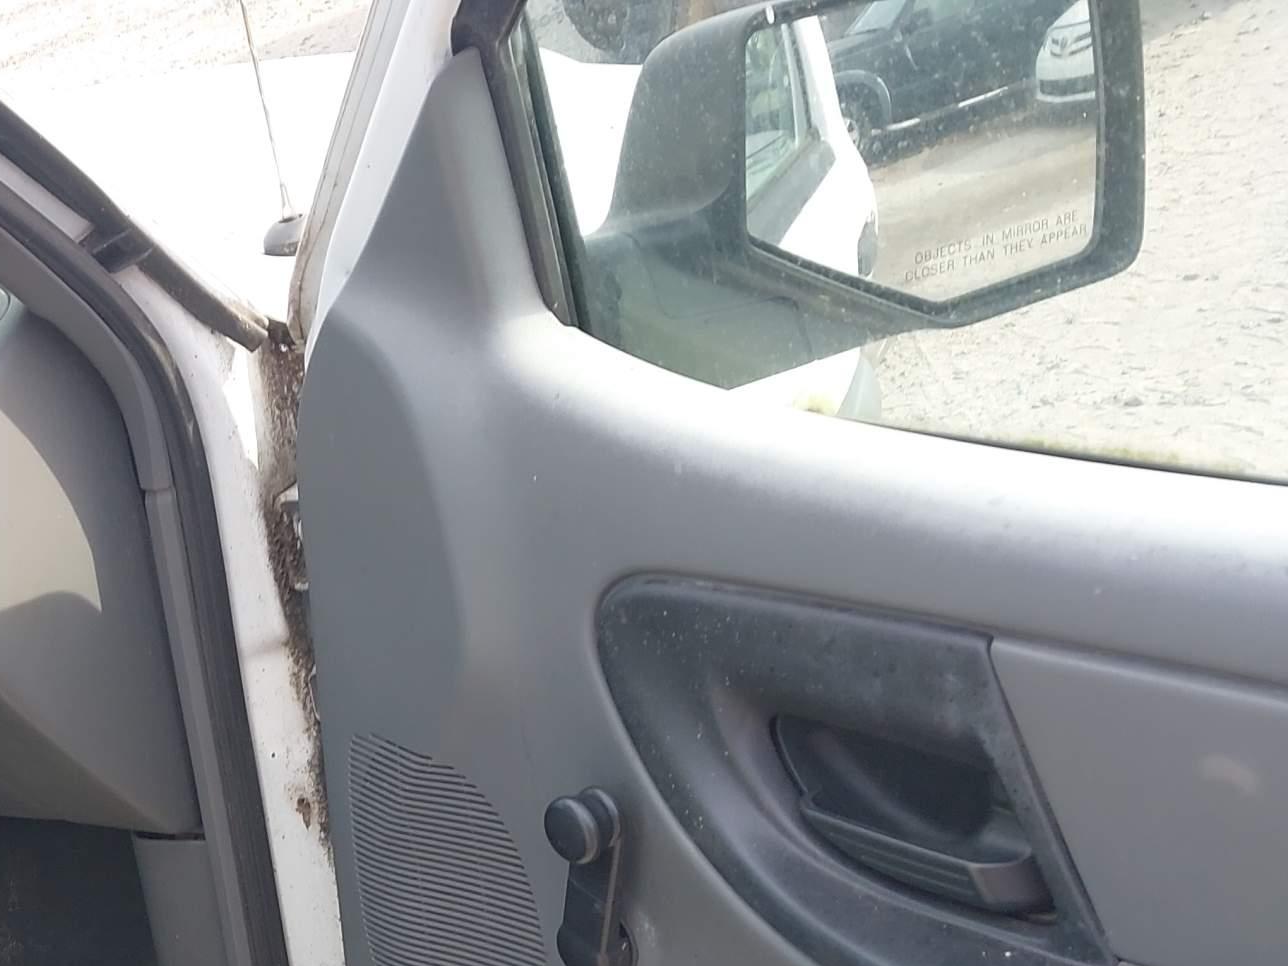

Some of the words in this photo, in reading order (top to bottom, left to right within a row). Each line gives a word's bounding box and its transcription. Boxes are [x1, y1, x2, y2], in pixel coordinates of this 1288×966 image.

[905, 260, 955, 281] CLOSER
[962, 249, 995, 266] THAN
[1003, 237, 1034, 257] THEY
[1040, 223, 1088, 246] APPEAR
[914, 240, 972, 265] OBJECTS
[982, 232, 994, 247] IN
[1001, 218, 1049, 241] MIRROR
[1055, 209, 1078, 226] ARE
